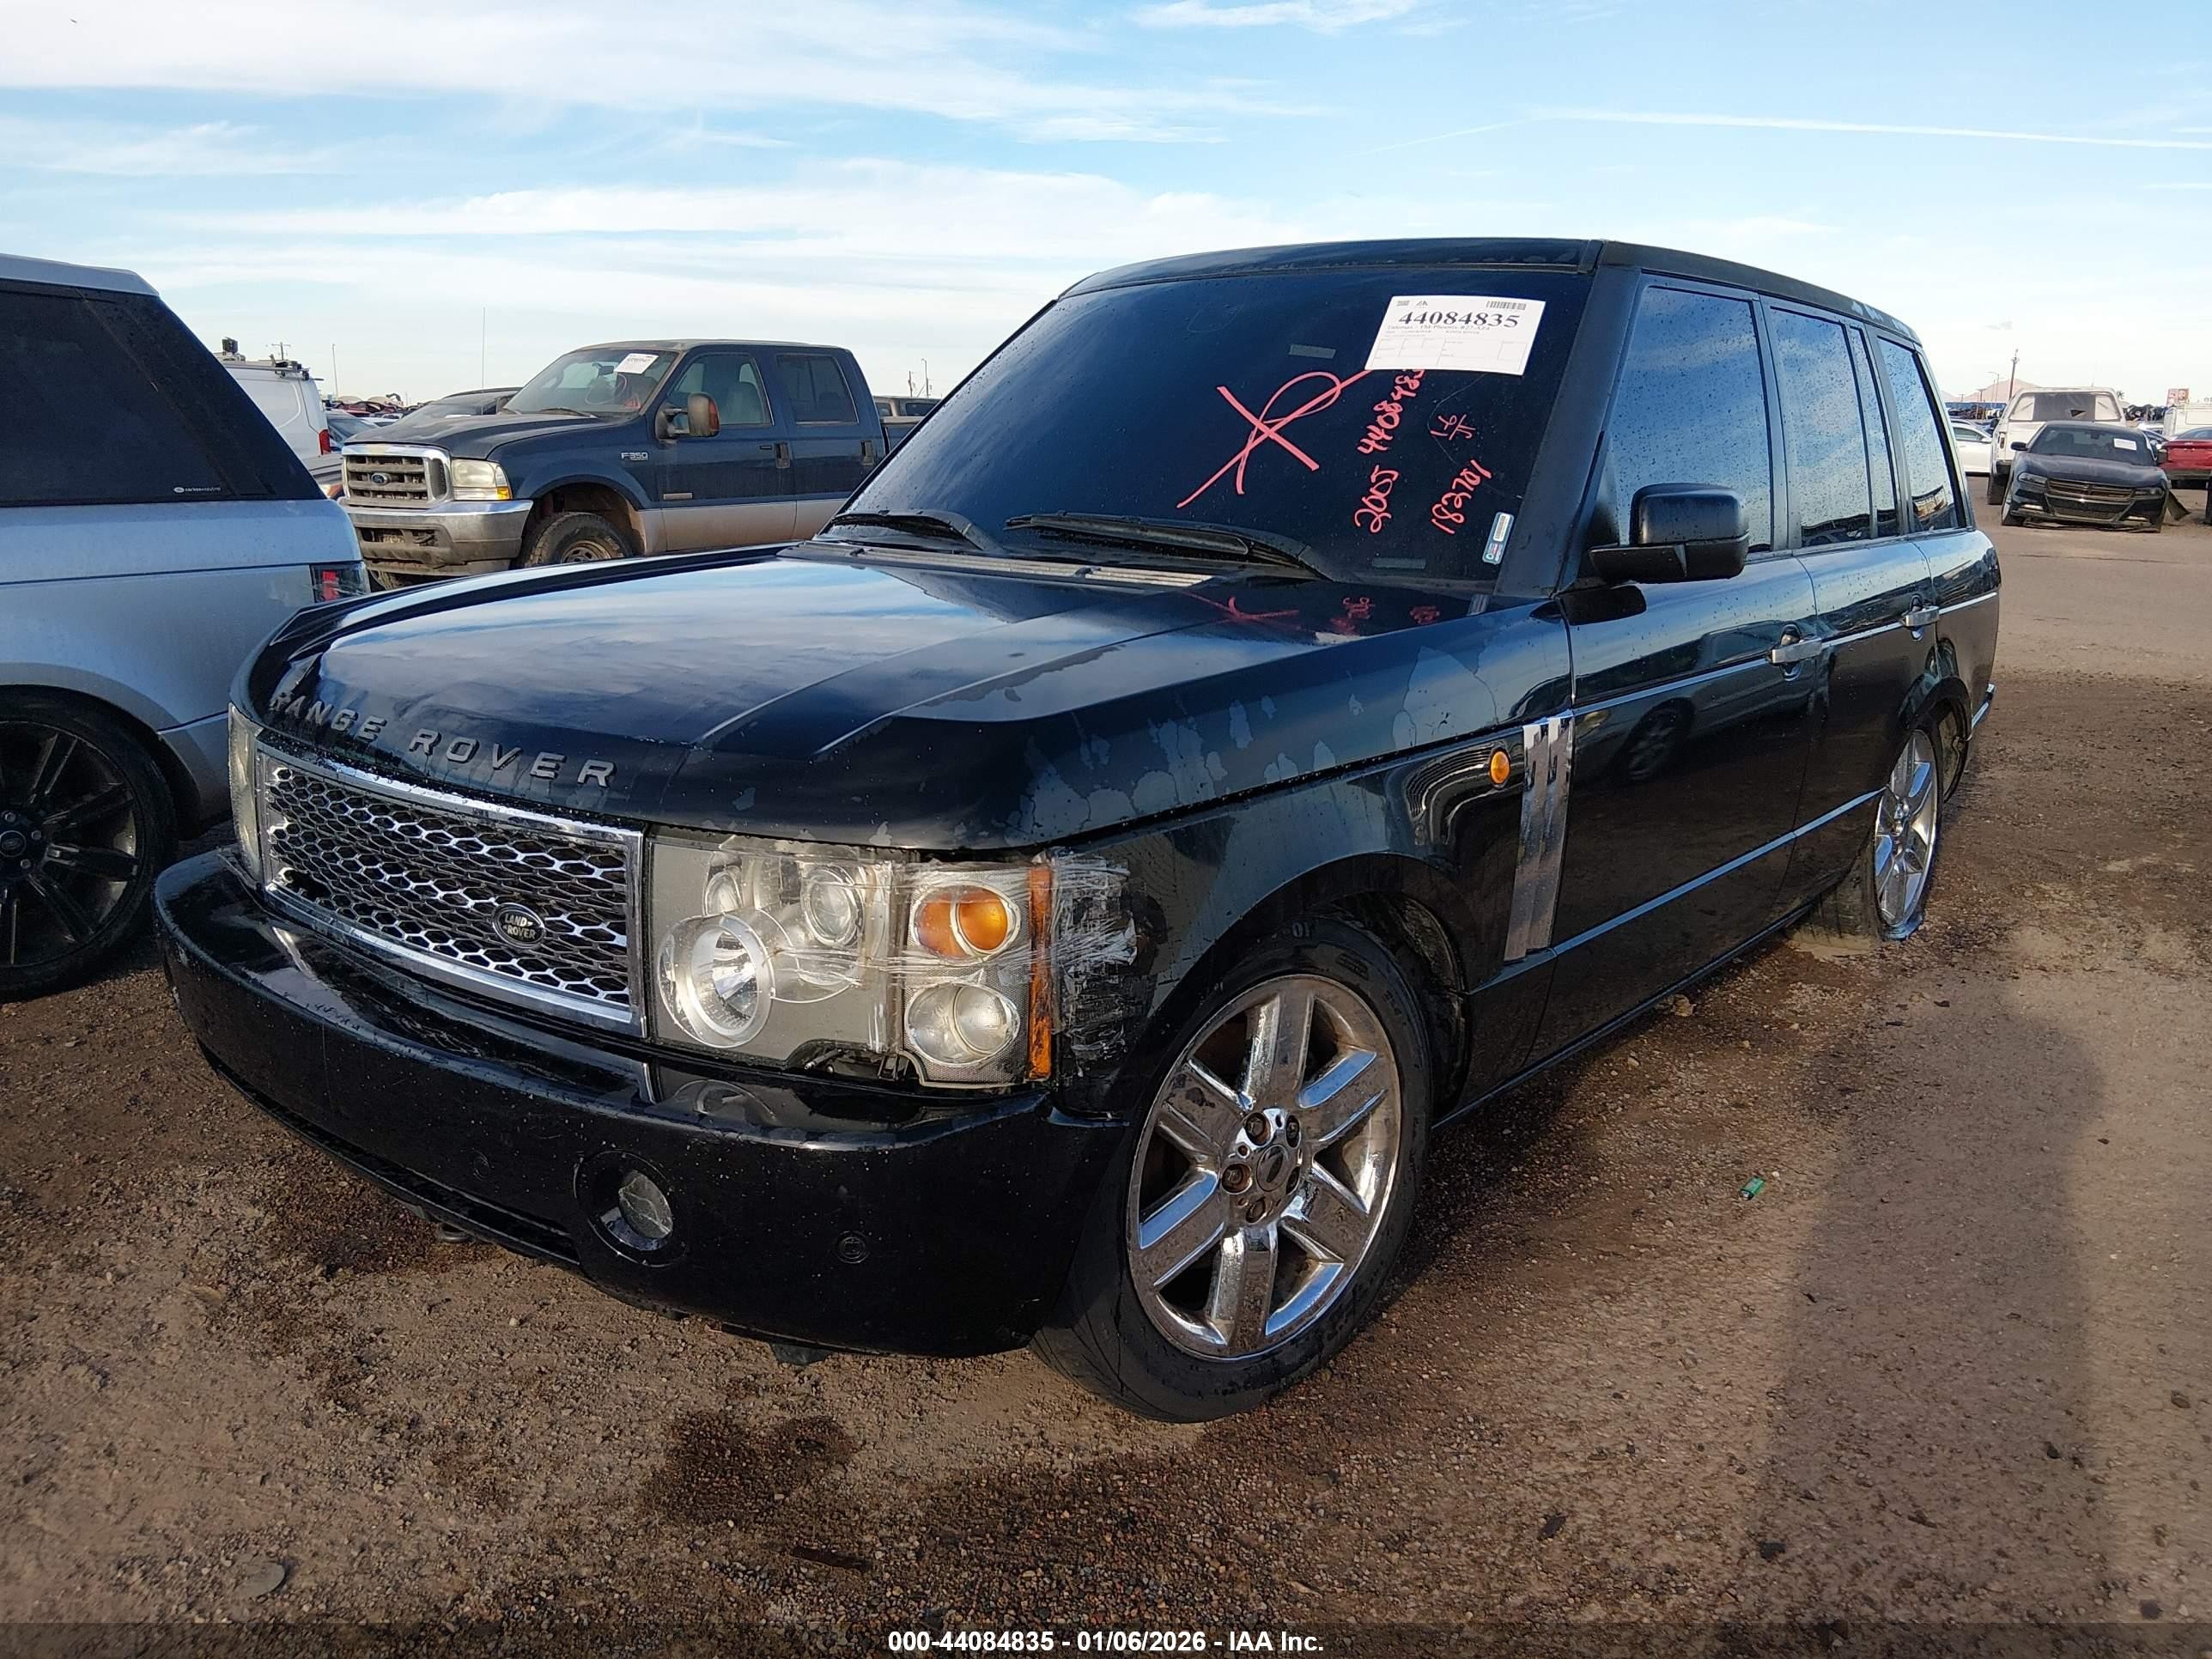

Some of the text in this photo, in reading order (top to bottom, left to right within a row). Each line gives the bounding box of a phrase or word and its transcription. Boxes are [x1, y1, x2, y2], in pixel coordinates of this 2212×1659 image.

[1399, 311, 1521, 328] 44084835
[268, 691, 617, 788] RANGE ROVER
[504, 913, 528, 927] LAND
[507, 924, 536, 939] ROVER
